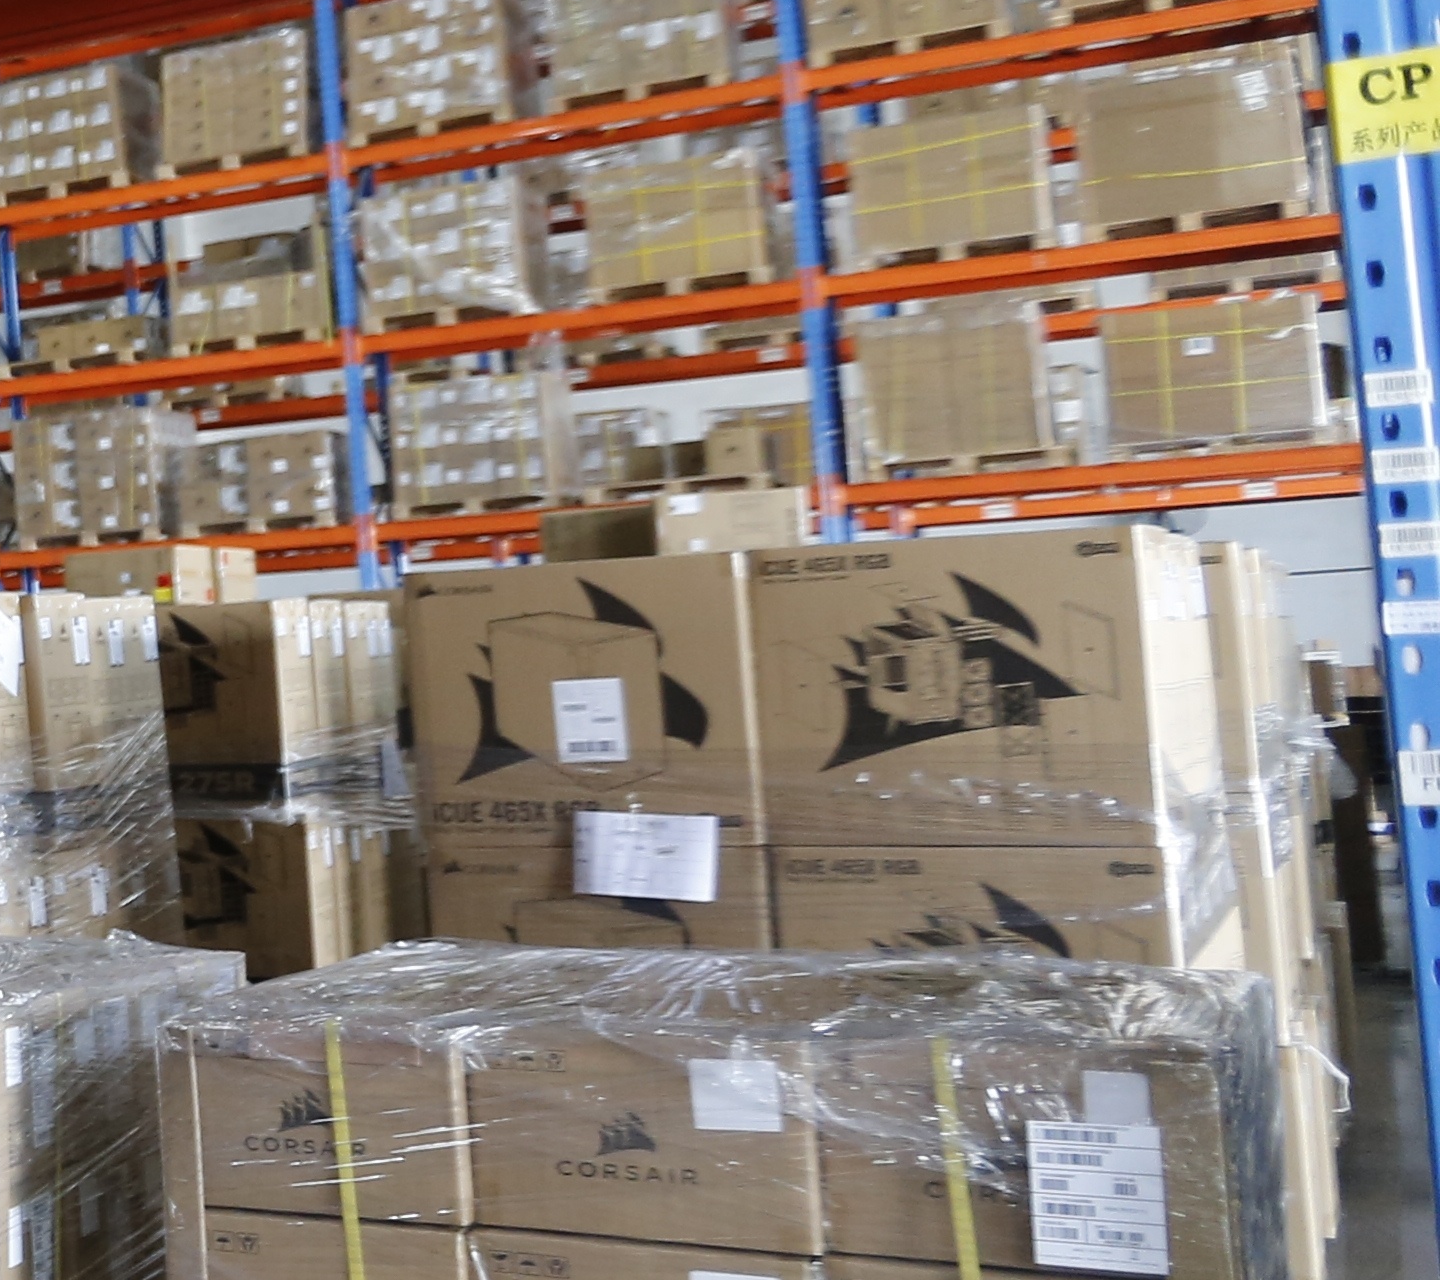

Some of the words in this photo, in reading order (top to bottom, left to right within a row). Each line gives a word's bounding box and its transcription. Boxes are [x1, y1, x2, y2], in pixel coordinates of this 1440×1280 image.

[1358, 63, 1432, 105] CP
[245, 1136, 367, 1156] CORSAR
[557, 1160, 699, 1185] CORSAIR
